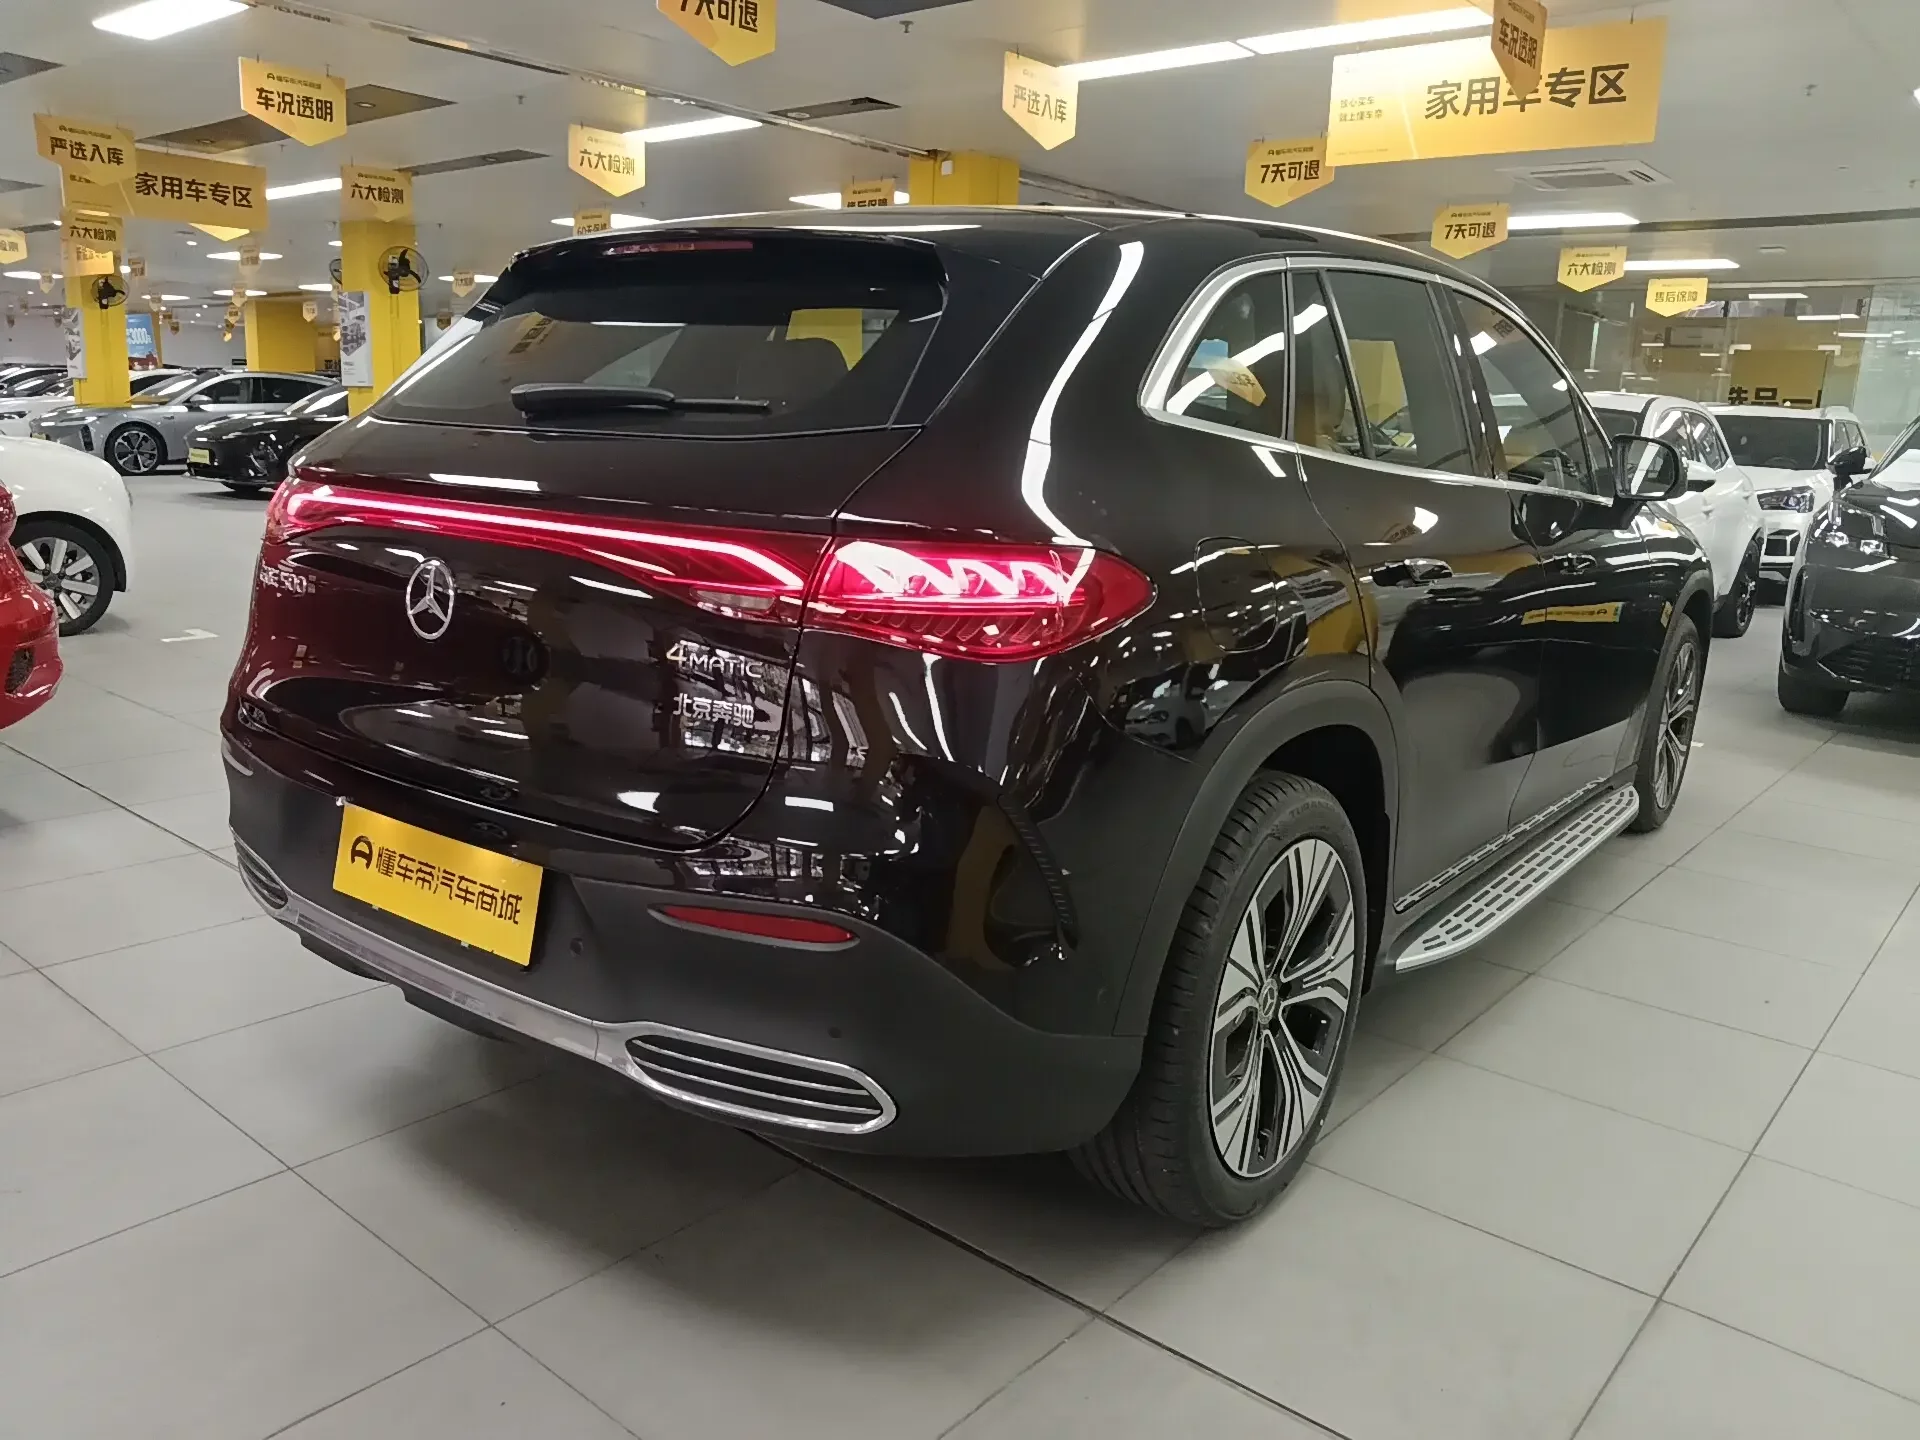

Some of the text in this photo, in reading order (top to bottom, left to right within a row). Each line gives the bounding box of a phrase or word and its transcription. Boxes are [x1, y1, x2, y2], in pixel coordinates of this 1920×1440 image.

[1499, 16, 1537, 69] 车况透明
[256, 87, 333, 122] 车况透明
[1013, 84, 1067, 123] 严选入库
[50, 136, 124, 165] 严选入库
[579, 149, 635, 176] 六大检测
[1260, 160, 1320, 183] 7天可退
[135, 172, 253, 208] 家用车专区
[351, 183, 404, 204] 六大检测
[69, 225, 117, 241] 六大检测
[1444, 222, 1496, 239] 7天可退
[1567, 261, 1616, 276] 六大检测
[1655, 290, 1698, 303] 售后保障
[666, 640, 763, 678] 4MATIC
[673, 693, 755, 729] 北京奔驰
[376, 846, 523, 925] 懂车帝汽车商城
